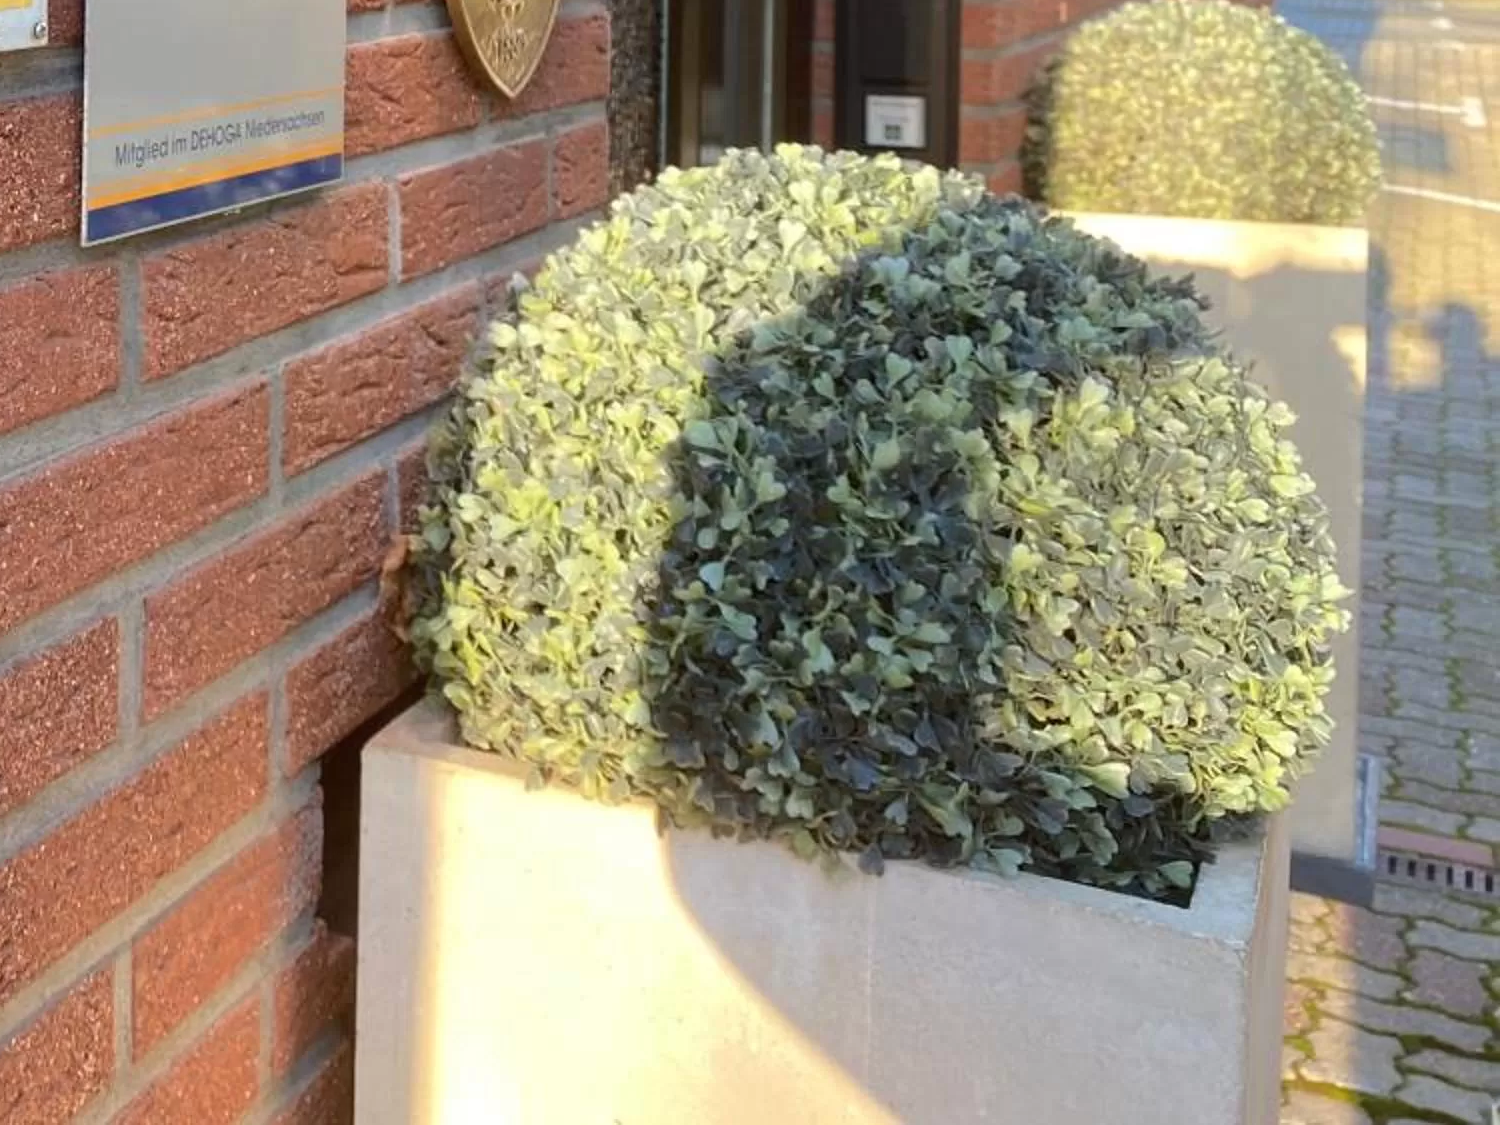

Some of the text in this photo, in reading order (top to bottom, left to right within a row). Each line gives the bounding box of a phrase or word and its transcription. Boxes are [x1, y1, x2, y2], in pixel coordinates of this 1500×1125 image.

[115, 110, 325, 168] Mitglied im DEHOGA Niedersachsen
